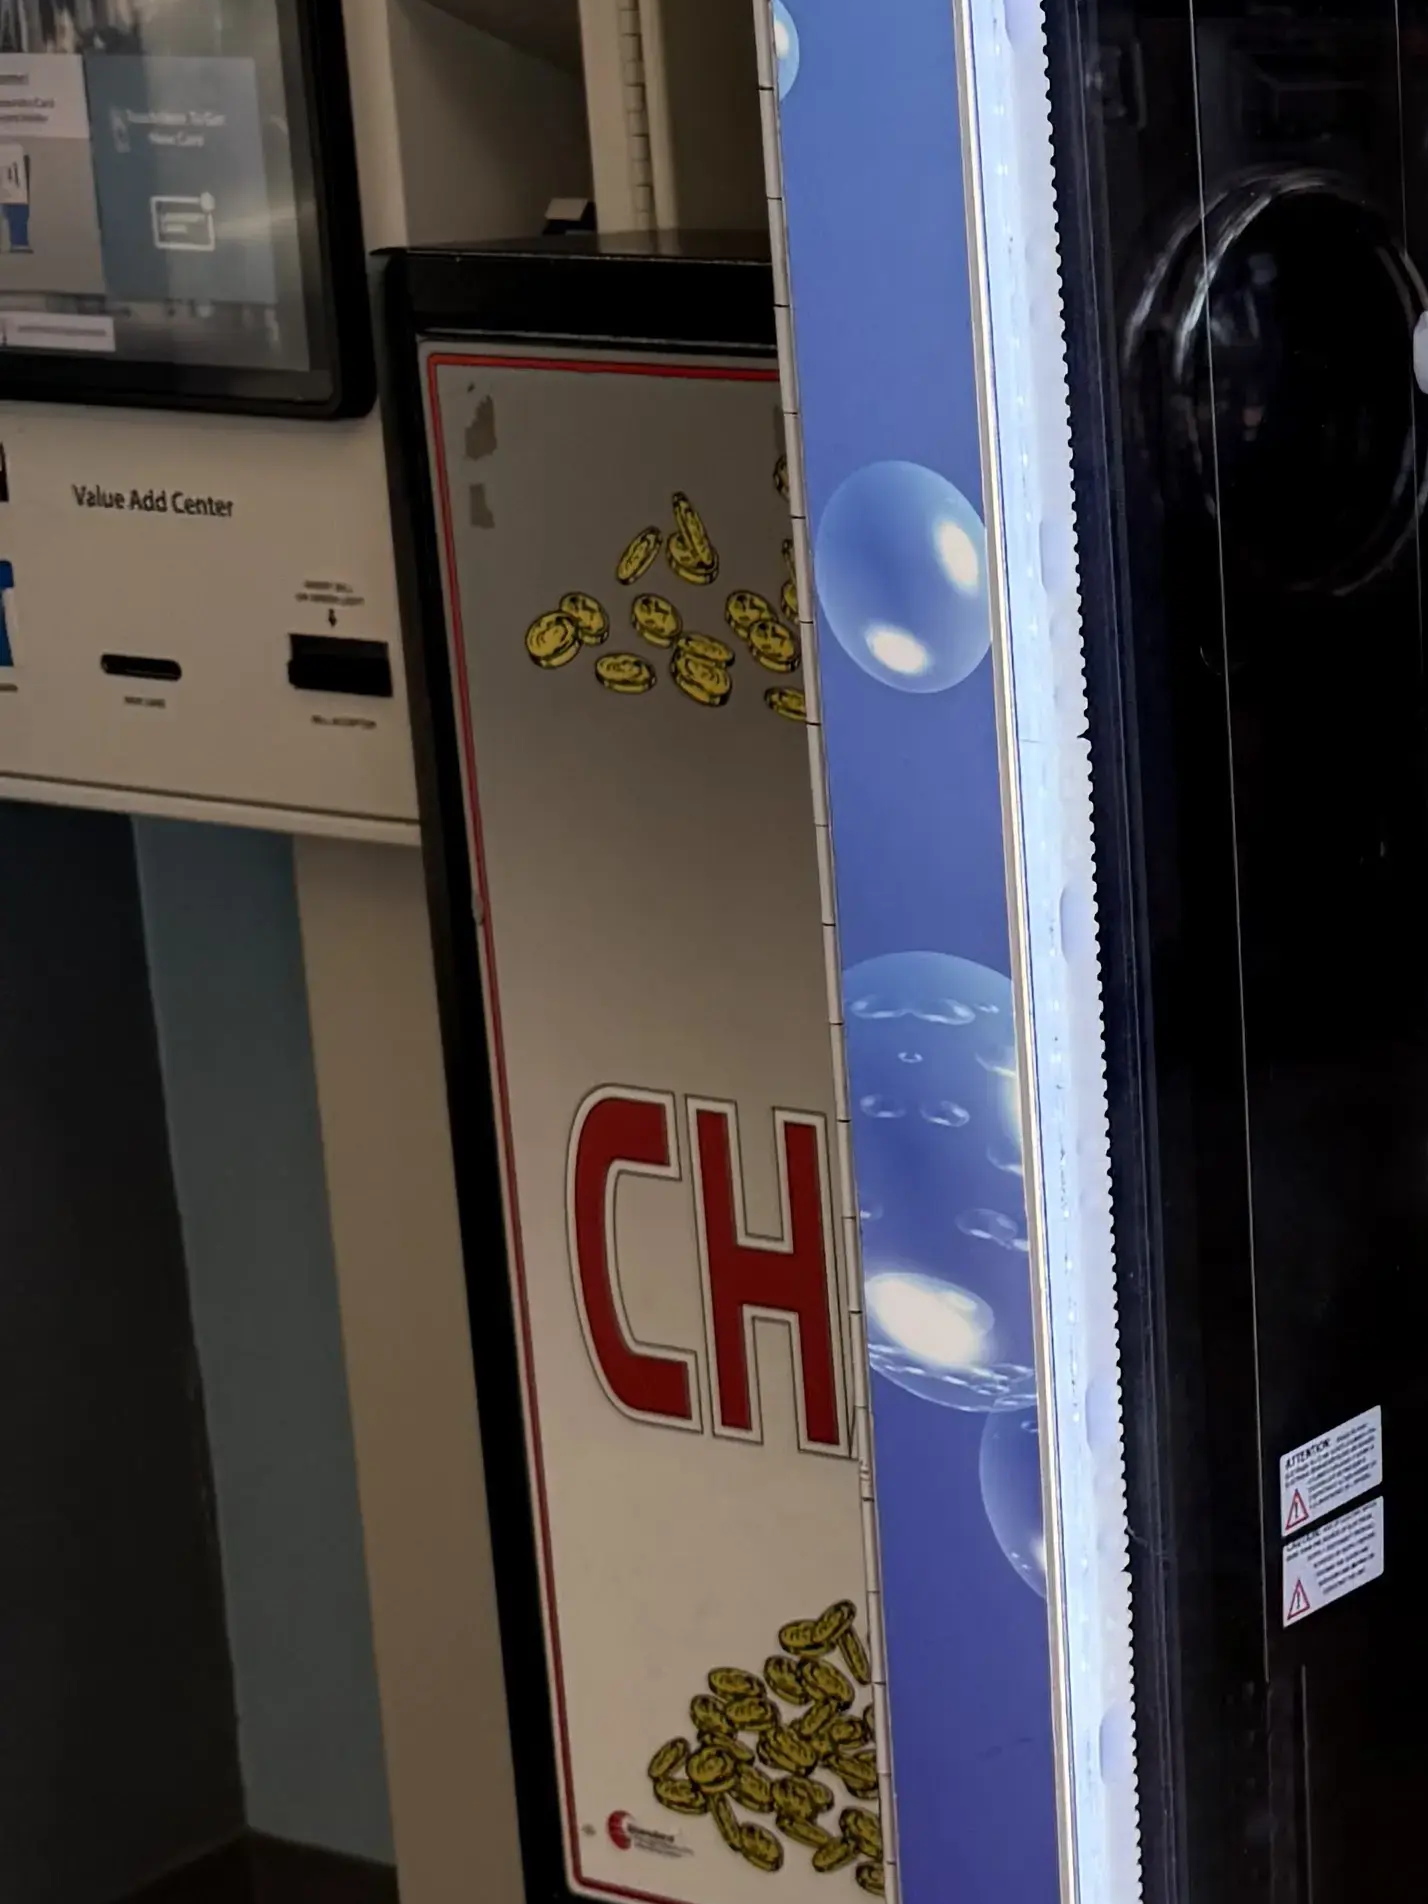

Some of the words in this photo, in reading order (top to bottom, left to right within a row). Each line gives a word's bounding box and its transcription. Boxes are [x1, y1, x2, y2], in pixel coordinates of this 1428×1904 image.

[72, 484, 125, 510] Value
[129, 489, 168, 514] Add
[172, 491, 235, 518] Center
